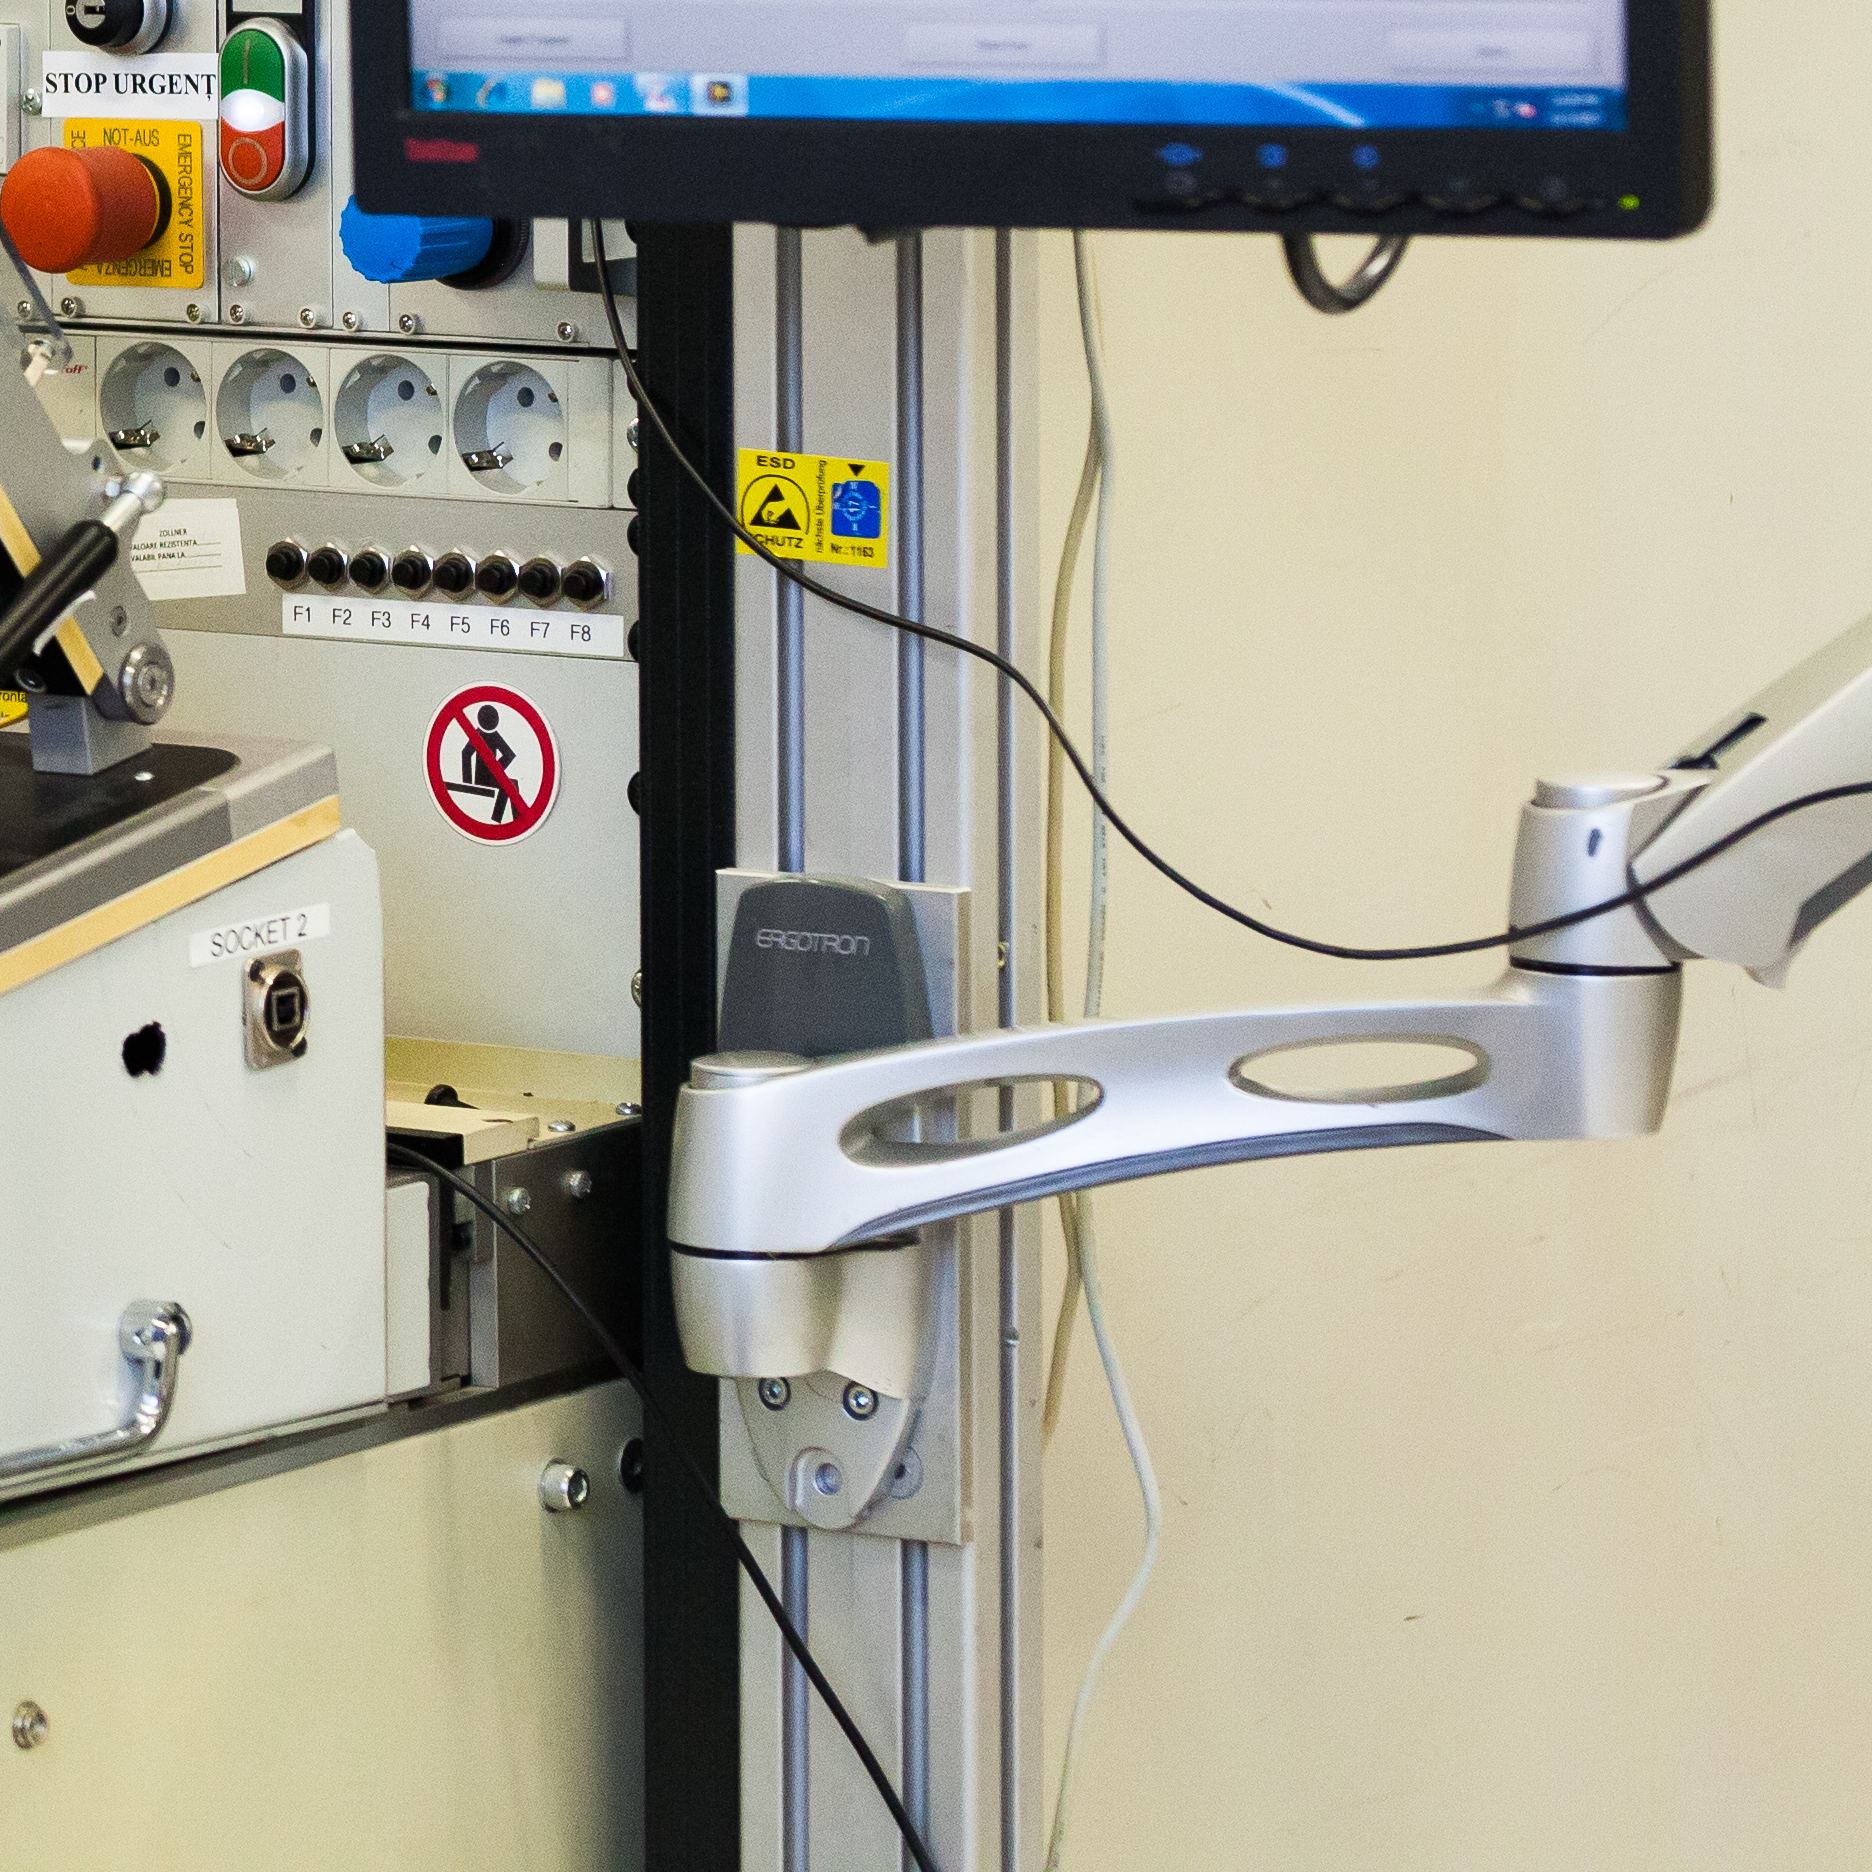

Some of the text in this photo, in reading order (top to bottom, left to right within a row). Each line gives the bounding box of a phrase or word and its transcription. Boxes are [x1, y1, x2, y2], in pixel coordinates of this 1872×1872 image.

[45, 73, 107, 95] STOP
[103, 128, 160, 146] NOT-AUS
[178, 133, 193, 274] EMERGENCY STOP
[97, 259, 172, 277] EMERGENZA
[756, 455, 795, 469] ESD
[755, 533, 803, 548] CHUTZ
[293, 606, 591, 642] F1 F2 F3 F4 F5 F6 F7 F8
[211, 913, 309, 958] SOCKET 2
[756, 929, 870, 956] ERGOTRON
